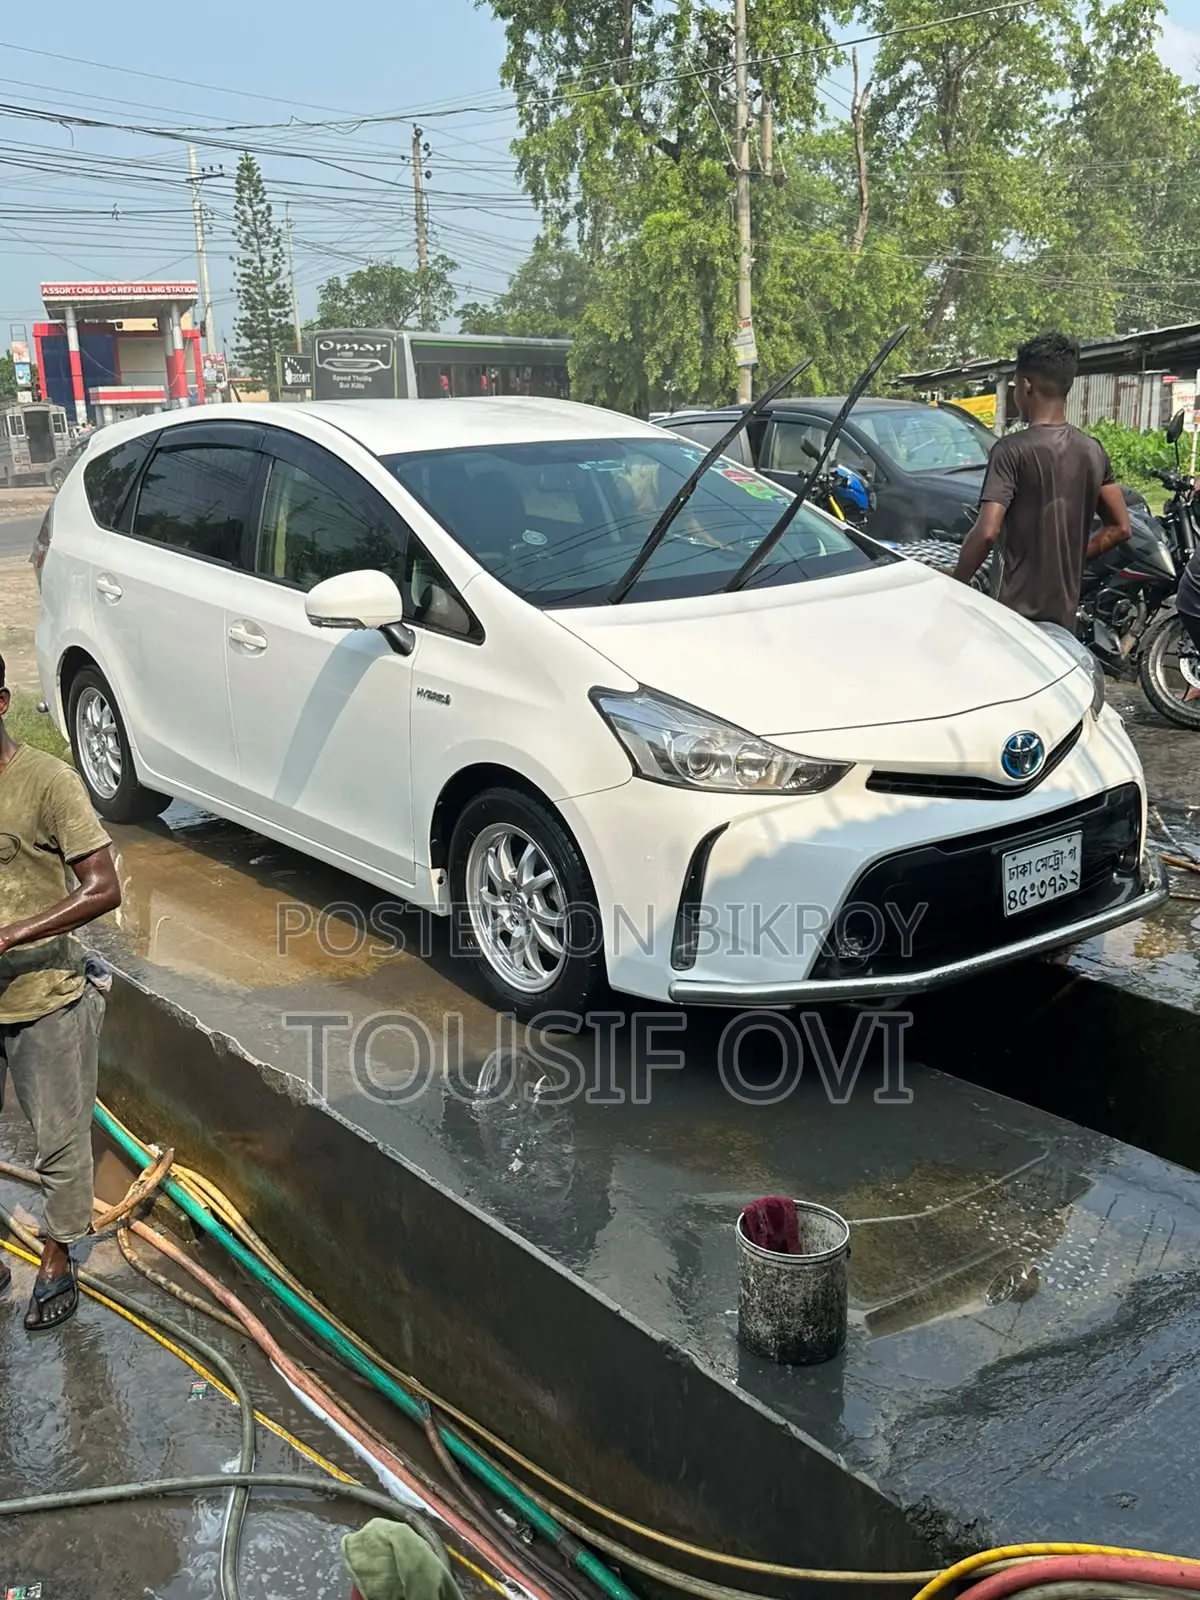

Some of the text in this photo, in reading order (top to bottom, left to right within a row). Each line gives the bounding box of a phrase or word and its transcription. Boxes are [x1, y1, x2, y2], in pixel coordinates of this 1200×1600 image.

[43, 286, 77, 295] ASSORT
[77, 286, 93, 295] CNG
[100, 286, 117, 295] LPG
[117, 285, 164, 295] REFUELLING
[165, 285, 198, 294] STATION
[319, 340, 387, 350] Omar
[332, 374, 352, 383] Speed
[1008, 861, 1032, 880] ঢাকা
